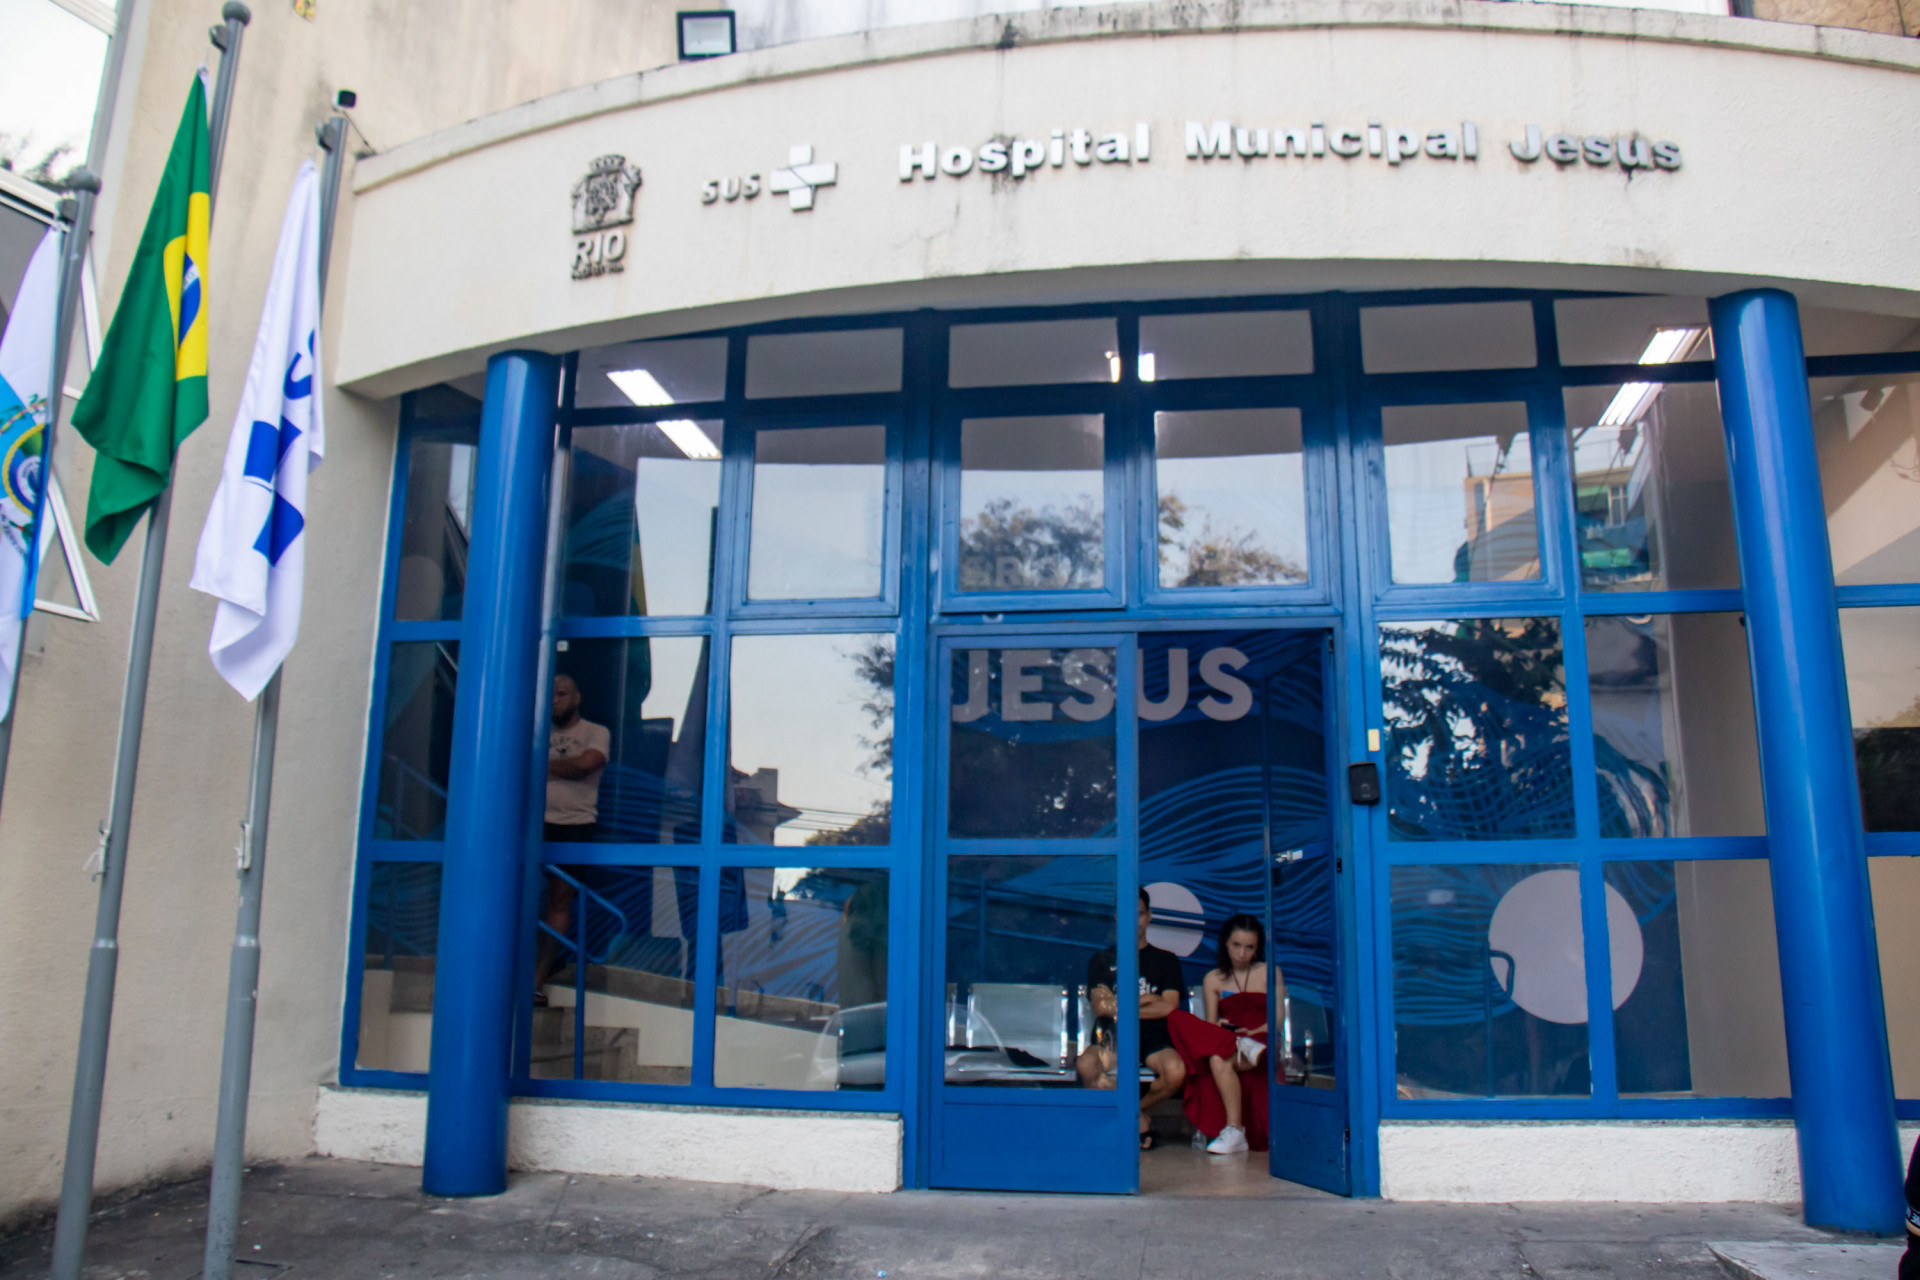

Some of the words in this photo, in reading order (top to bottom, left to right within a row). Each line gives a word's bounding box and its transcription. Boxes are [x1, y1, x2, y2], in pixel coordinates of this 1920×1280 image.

[899, 122, 1149, 183] Hospital
[1186, 119, 1477, 165] Municipal
[1510, 123, 1682, 171] Jesus
[702, 175, 762, 205] SUS
[572, 229, 627, 270] RIO
[952, 647, 1253, 722] JESUS
